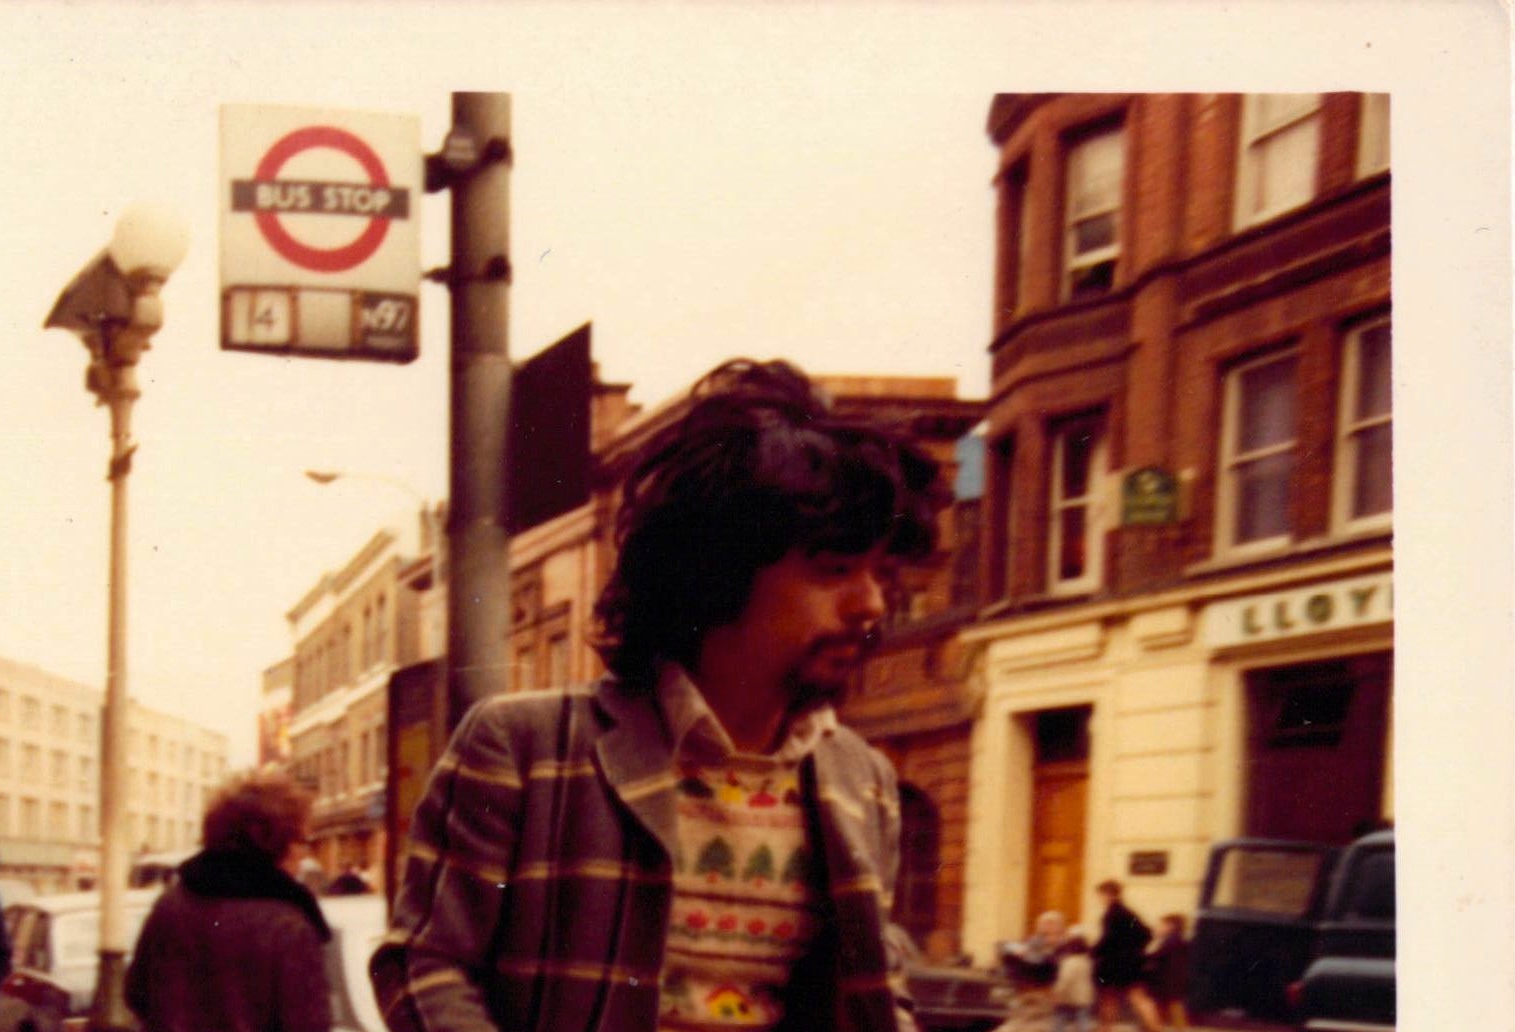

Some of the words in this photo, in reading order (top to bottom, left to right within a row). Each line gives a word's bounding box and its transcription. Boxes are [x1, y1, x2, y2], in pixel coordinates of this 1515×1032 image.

[255, 184, 311, 209] BUS
[323, 187, 391, 213] STOP
[1241, 583, 1394, 635] LLOY
